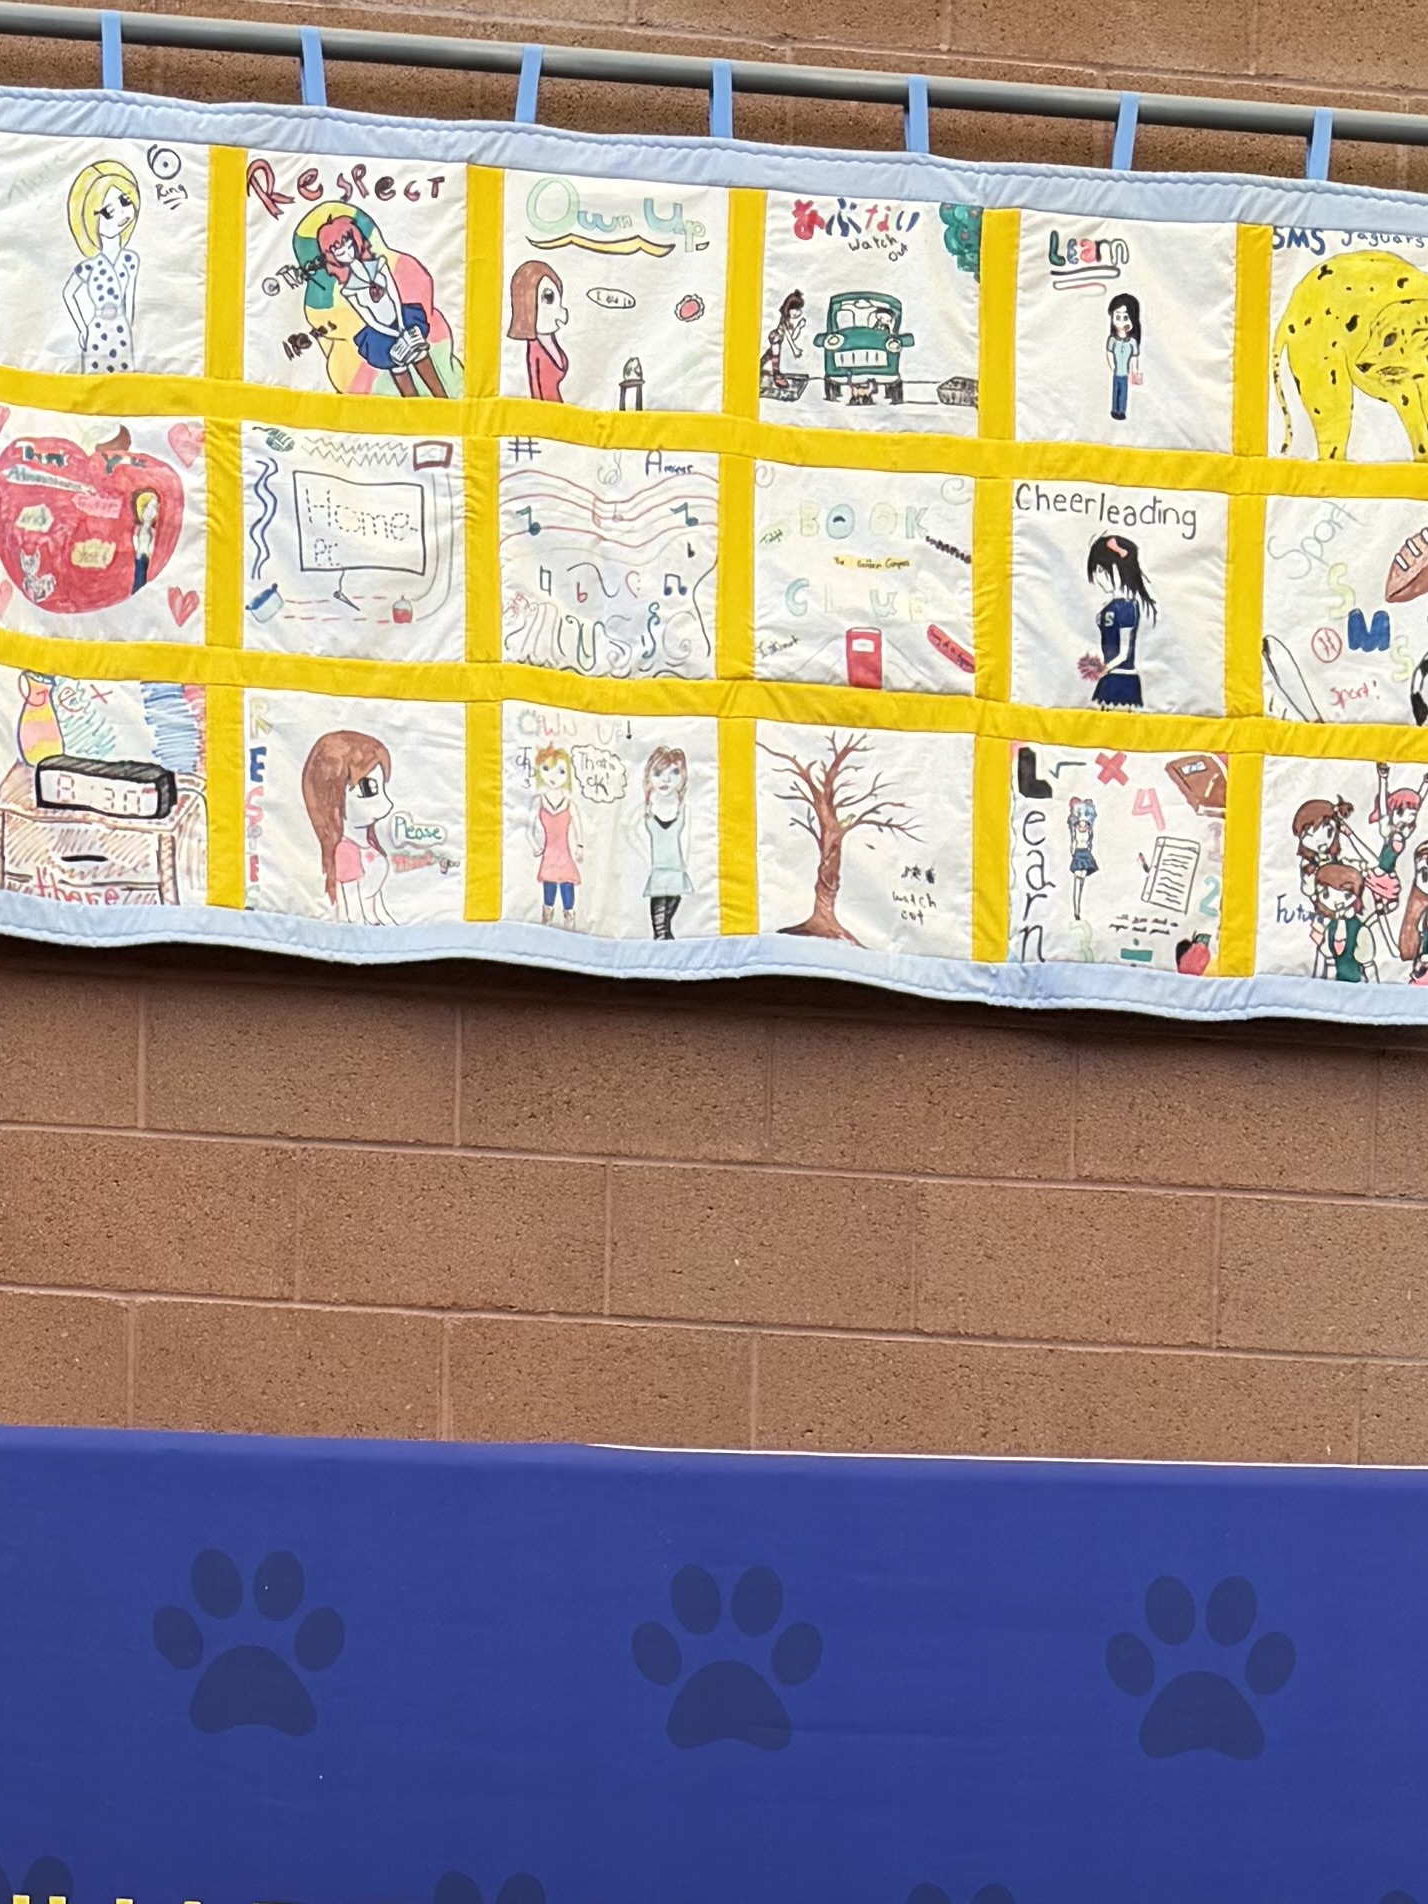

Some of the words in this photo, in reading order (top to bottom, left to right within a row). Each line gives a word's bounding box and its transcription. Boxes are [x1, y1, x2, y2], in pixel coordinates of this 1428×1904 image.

[156, 183, 188, 200] Ring
[526, 177, 632, 234] Own
[1048, 230, 1130, 267] Learn
[1272, 227, 1326, 255] SMS
[1341, 231, 1425, 249] Jaguars
[799, 502, 929, 539] BOOK
[1015, 483, 1196, 540] Cheerleading
[395, 816, 443, 840] Please
